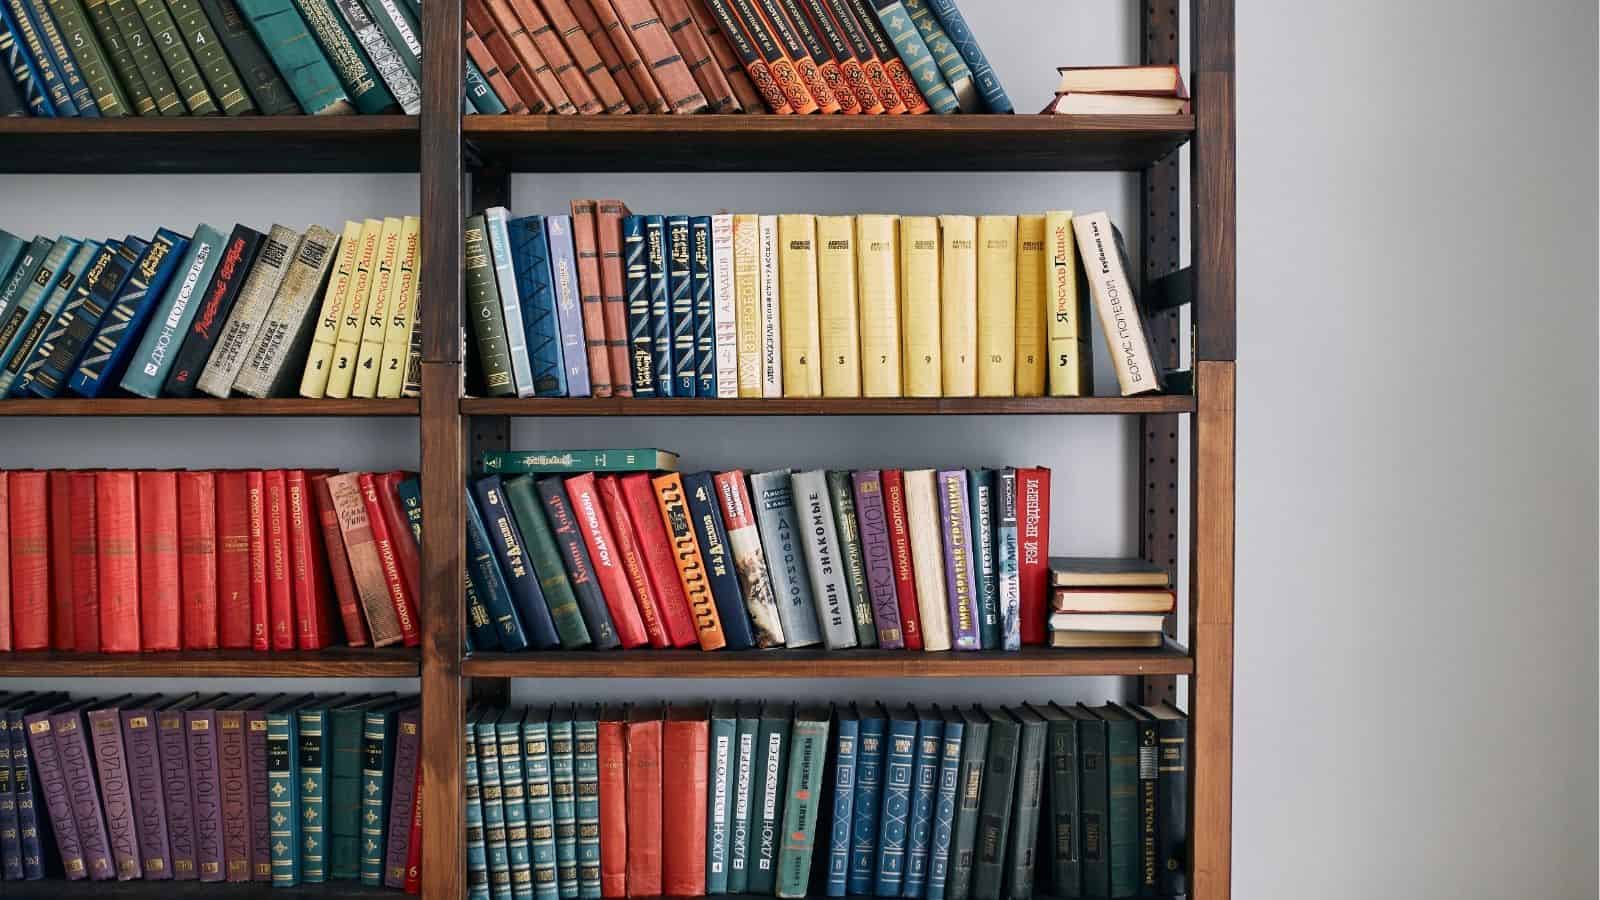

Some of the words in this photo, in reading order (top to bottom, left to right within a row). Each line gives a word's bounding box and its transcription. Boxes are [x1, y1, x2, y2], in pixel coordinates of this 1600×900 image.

[74, 33, 84, 47] 5
[111, 38, 120, 49] 1
[134, 34, 144, 48] 2
[162, 32, 173, 45] 3
[196, 31, 206, 45] 4
[324, 276, 349, 330] Ярослав
[346, 272, 368, 328] Ярослав
[370, 272, 390, 328] Ярослав
[394, 272, 412, 328] Ярослав
[482, 306, 491, 318] 6
[1056, 266, 1069, 323] Ярослав
[1106, 279, 1129, 338] ПОЛЕВОЙ
[152, 324, 174, 365] ДЖОН
[339, 357, 348, 368] 3
[364, 358, 372, 368] 4
[390, 358, 398, 370] 2
[1059, 354, 1068, 366] 5
[1122, 338, 1142, 382] БОРИС
[315, 360, 322, 370] 1
[580, 492, 598, 530] ОКЕАНА
[696, 486, 706, 502] 4
[890, 486, 904, 535] ШОЛОХОВ
[948, 476, 964, 545] СТРУГАЦКИХ
[1026, 479, 1040, 538] БРЭДБЕРИ
[594, 536, 612, 567] ЛЮДИ
[809, 492, 833, 574] ЗНАКОМЫЕ
[896, 538, 910, 581] МИХАИЛ
[954, 547, 970, 595] БРАТЬЕВ
[380, 540, 398, 581] МИХАИЛ
[392, 583, 412, 631] ШОЛОХОВ
[826, 583, 842, 626] НАШИ
[907, 620, 915, 632] 3
[959, 598, 972, 630] МИРЫ
[738, 734, 752, 816] ГОЛСУОРСИ
[766, 734, 780, 816] ГОЛСУОРСИ
[713, 822, 725, 862] ДЖОН
[734, 819, 746, 858] ДЖОН
[761, 820, 774, 858] ДЖОН
[409, 866, 417, 878] 6
